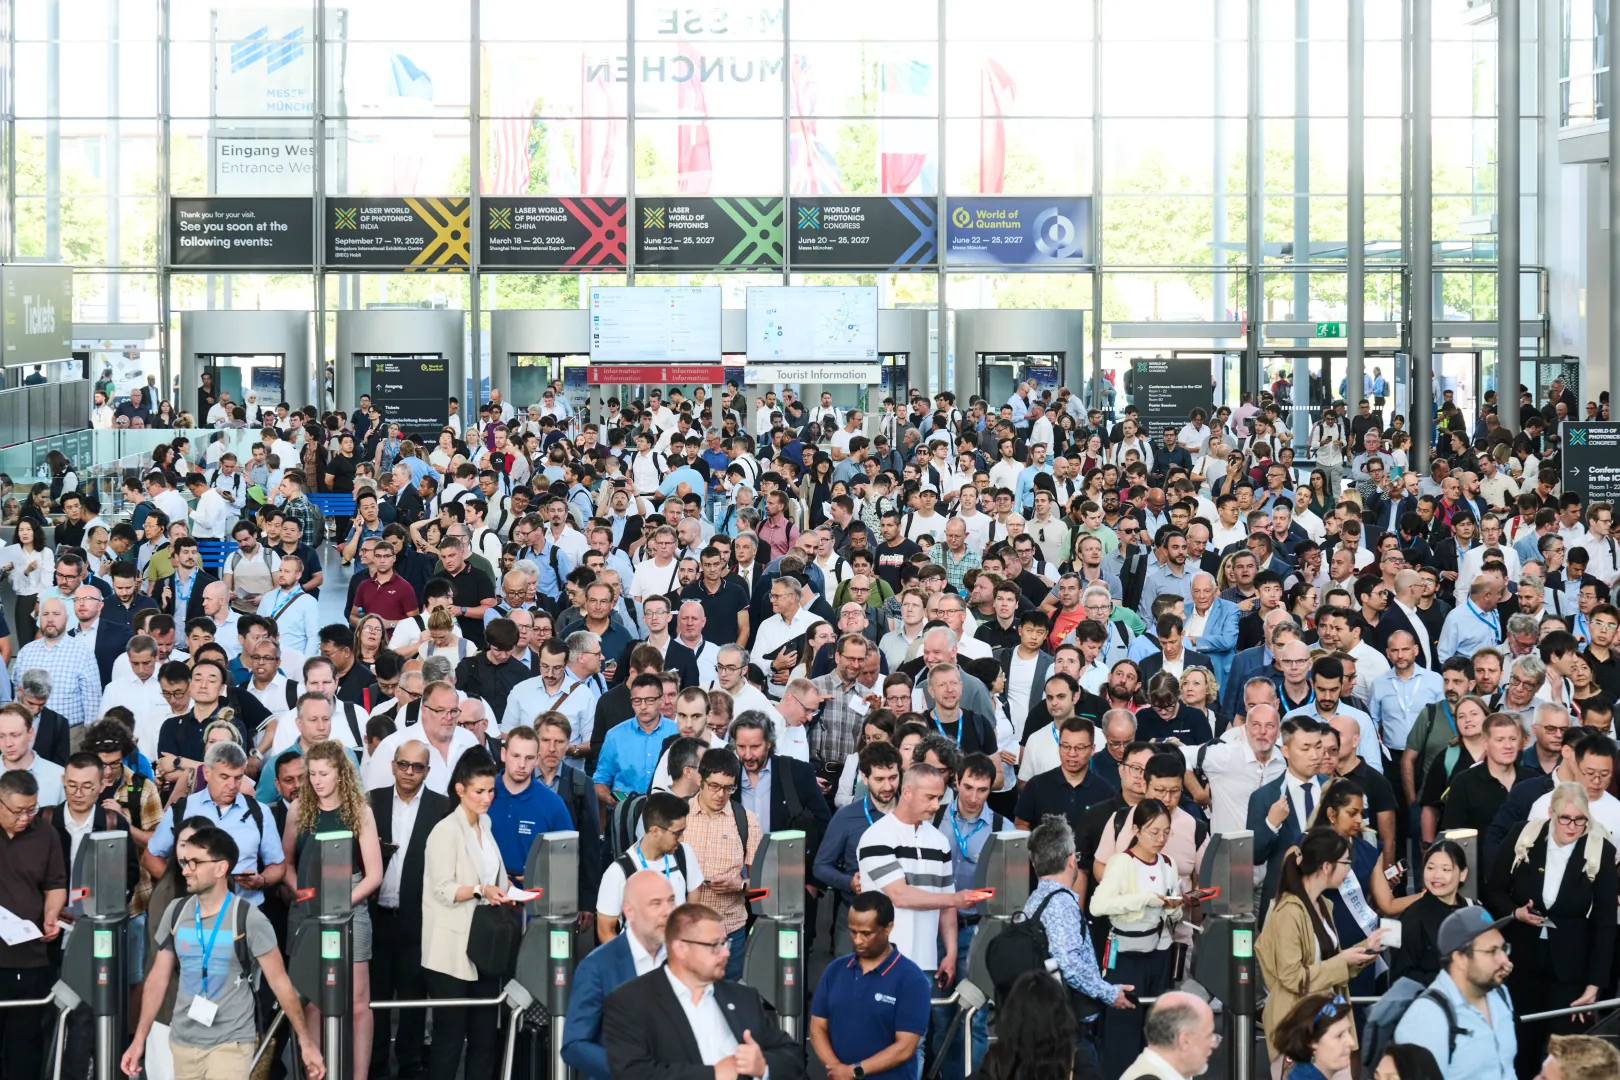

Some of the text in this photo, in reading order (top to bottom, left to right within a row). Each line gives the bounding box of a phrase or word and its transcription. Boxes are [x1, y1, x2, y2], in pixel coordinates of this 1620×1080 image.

[266, 101, 314, 112] MÜNCHE
[222, 144, 314, 158] Eingang Wes
[222, 162, 318, 174] Entrance Wes
[976, 210, 1018, 220] World of
[180, 221, 288, 234] See you soon at the
[976, 220, 1021, 229] Quantum
[180, 236, 273, 249] following events:
[335, 237, 373, 246] September
[23, 294, 55, 334] Tickets
[776, 369, 867, 379] Tourist Information
